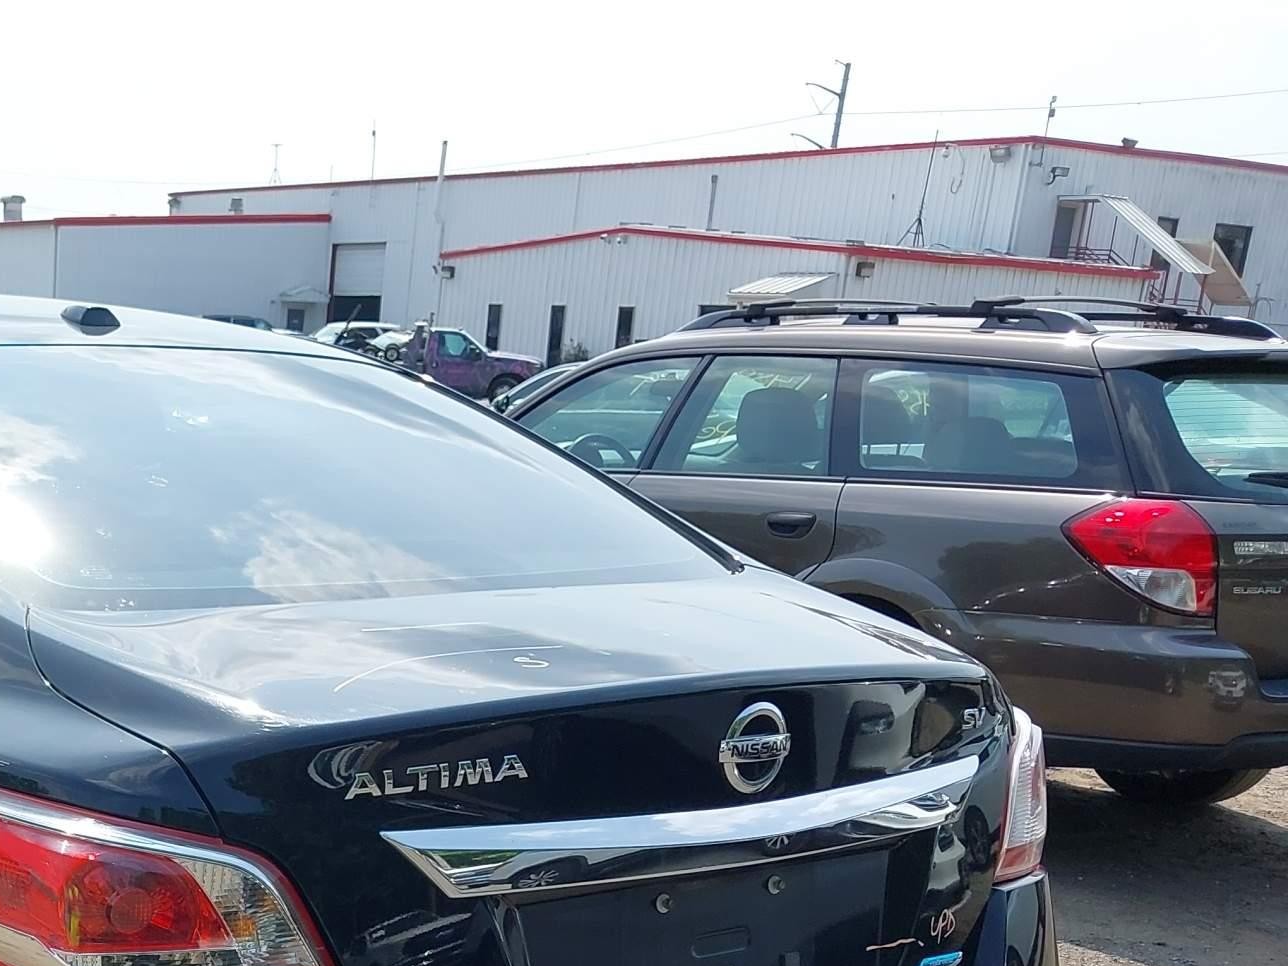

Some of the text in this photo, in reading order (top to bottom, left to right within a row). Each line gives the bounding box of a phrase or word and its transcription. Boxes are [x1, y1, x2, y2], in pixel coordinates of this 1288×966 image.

[1233, 586, 1282, 595] SUBARU
[962, 707, 986, 729] SV
[731, 739, 788, 758] NISSAN
[344, 754, 528, 800] ALTIMA
